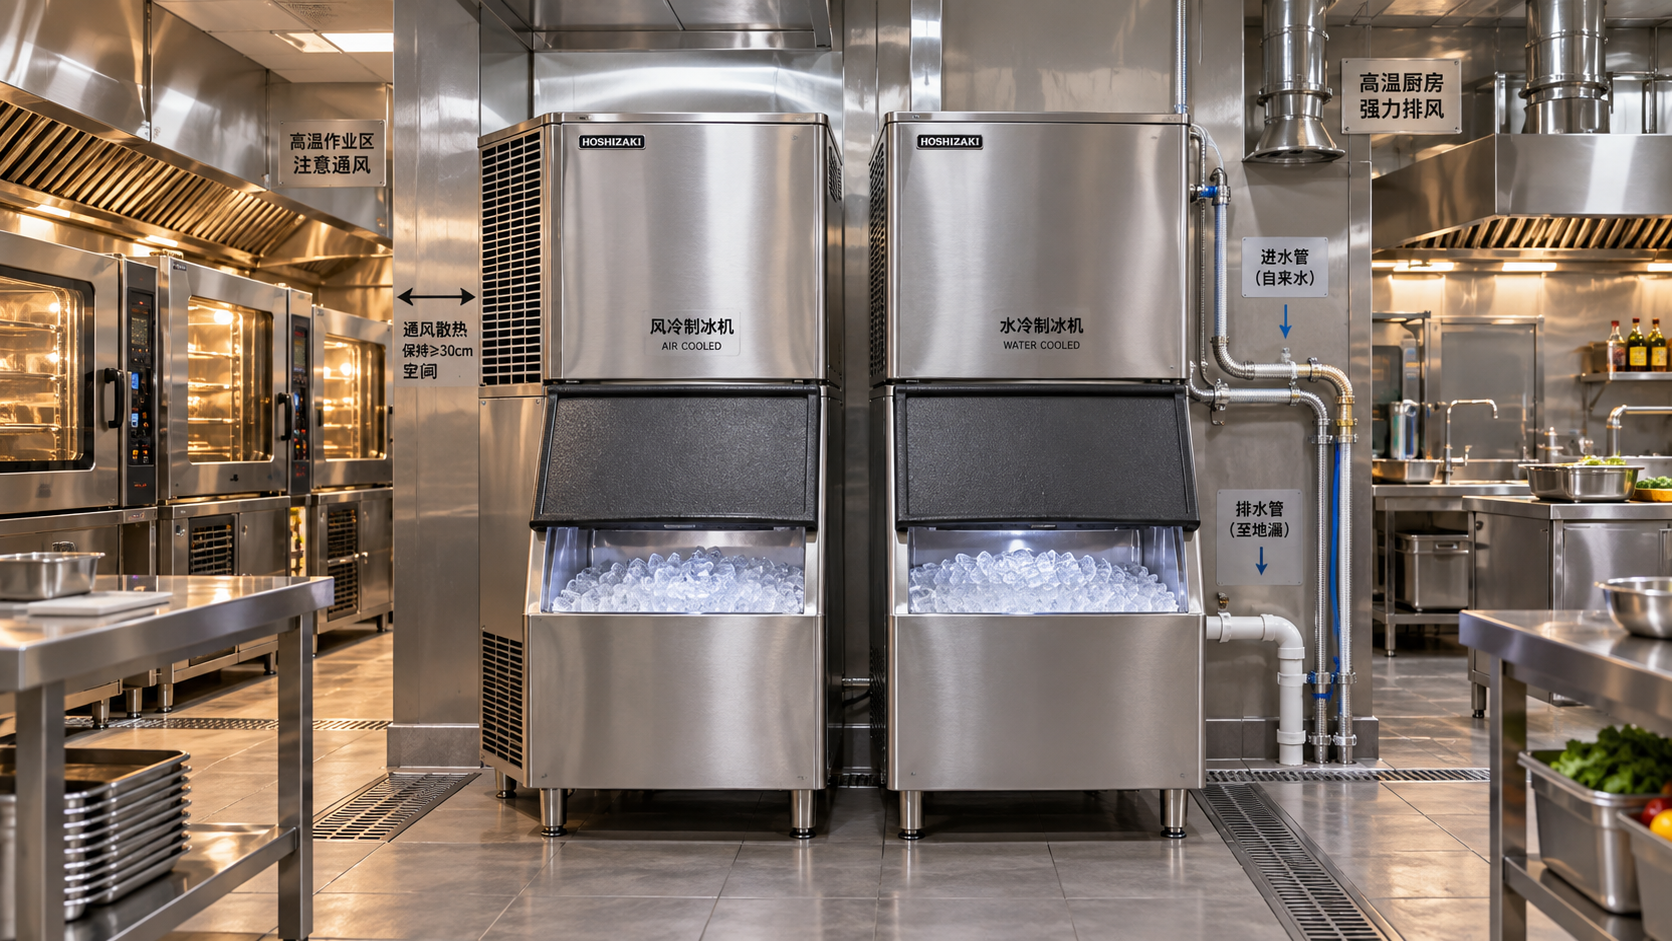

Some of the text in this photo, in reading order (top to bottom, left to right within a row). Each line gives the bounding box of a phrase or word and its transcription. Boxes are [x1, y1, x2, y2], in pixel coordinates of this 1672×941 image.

[1359, 72, 1444, 94] 高温厨房
[1359, 97, 1445, 120] 强力排风
[289, 132, 375, 151] 高温作业区
[582, 137, 642, 147] HOSHIZAKI
[920, 137, 980, 146] HOSHIZAKI
[293, 155, 371, 175] 注意通风
[1260, 248, 1309, 266] 进水管
[1256, 269, 1314, 287] （自来水）
[649, 317, 735, 336] 风冷制冰机
[999, 317, 1084, 335] 水冷制冰机
[661, 341, 722, 351] AIR COOLED
[1003, 341, 1081, 350] WATER COOLED
[1235, 500, 1284, 518] 排水管
